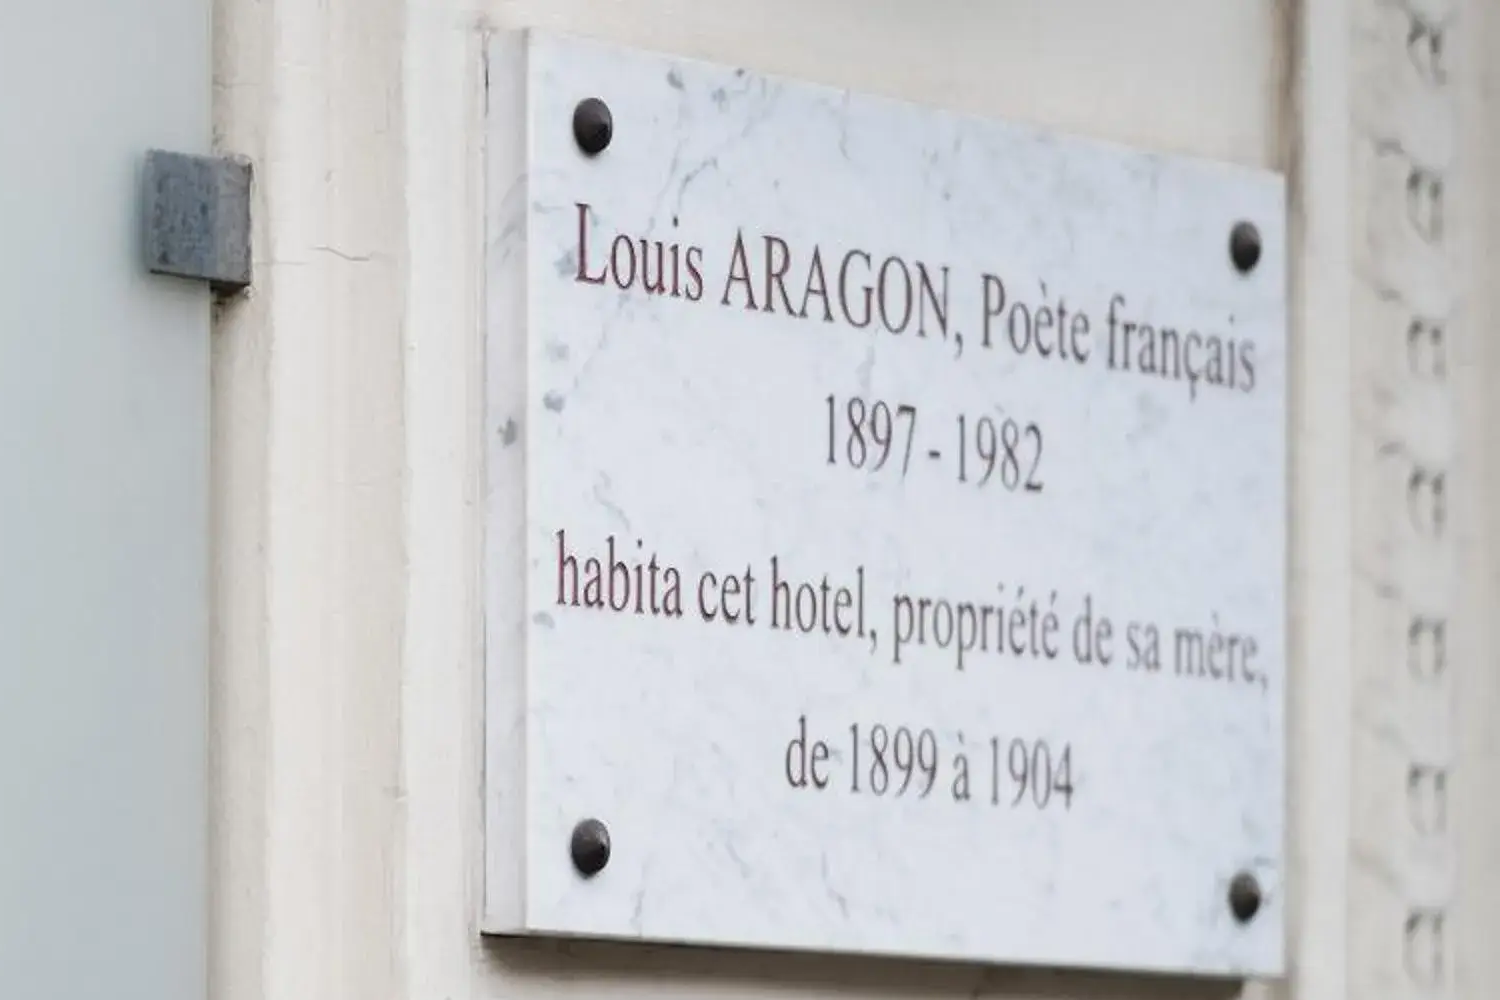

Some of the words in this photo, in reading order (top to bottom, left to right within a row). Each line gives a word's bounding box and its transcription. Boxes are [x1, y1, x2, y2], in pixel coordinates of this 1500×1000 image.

[574, 202, 704, 303] Louis
[722, 228, 964, 358] ARAGON,
[980, 272, 1092, 365] Poète
[1106, 294, 1257, 400] français
[555, 529, 683, 618] habita
[697, 564, 757, 625] cet
[769, 555, 878, 651] hotel,
[892, 582, 1061, 671] propriété
[1072, 595, 1114, 666] de
[1125, 621, 1162, 673] sa
[1173, 611, 1269, 692] mère,
[785, 716, 831, 790] de
[848, 722, 938, 798] 1899
[952, 732, 970, 800] à
[990, 737, 1074, 808] 1904
